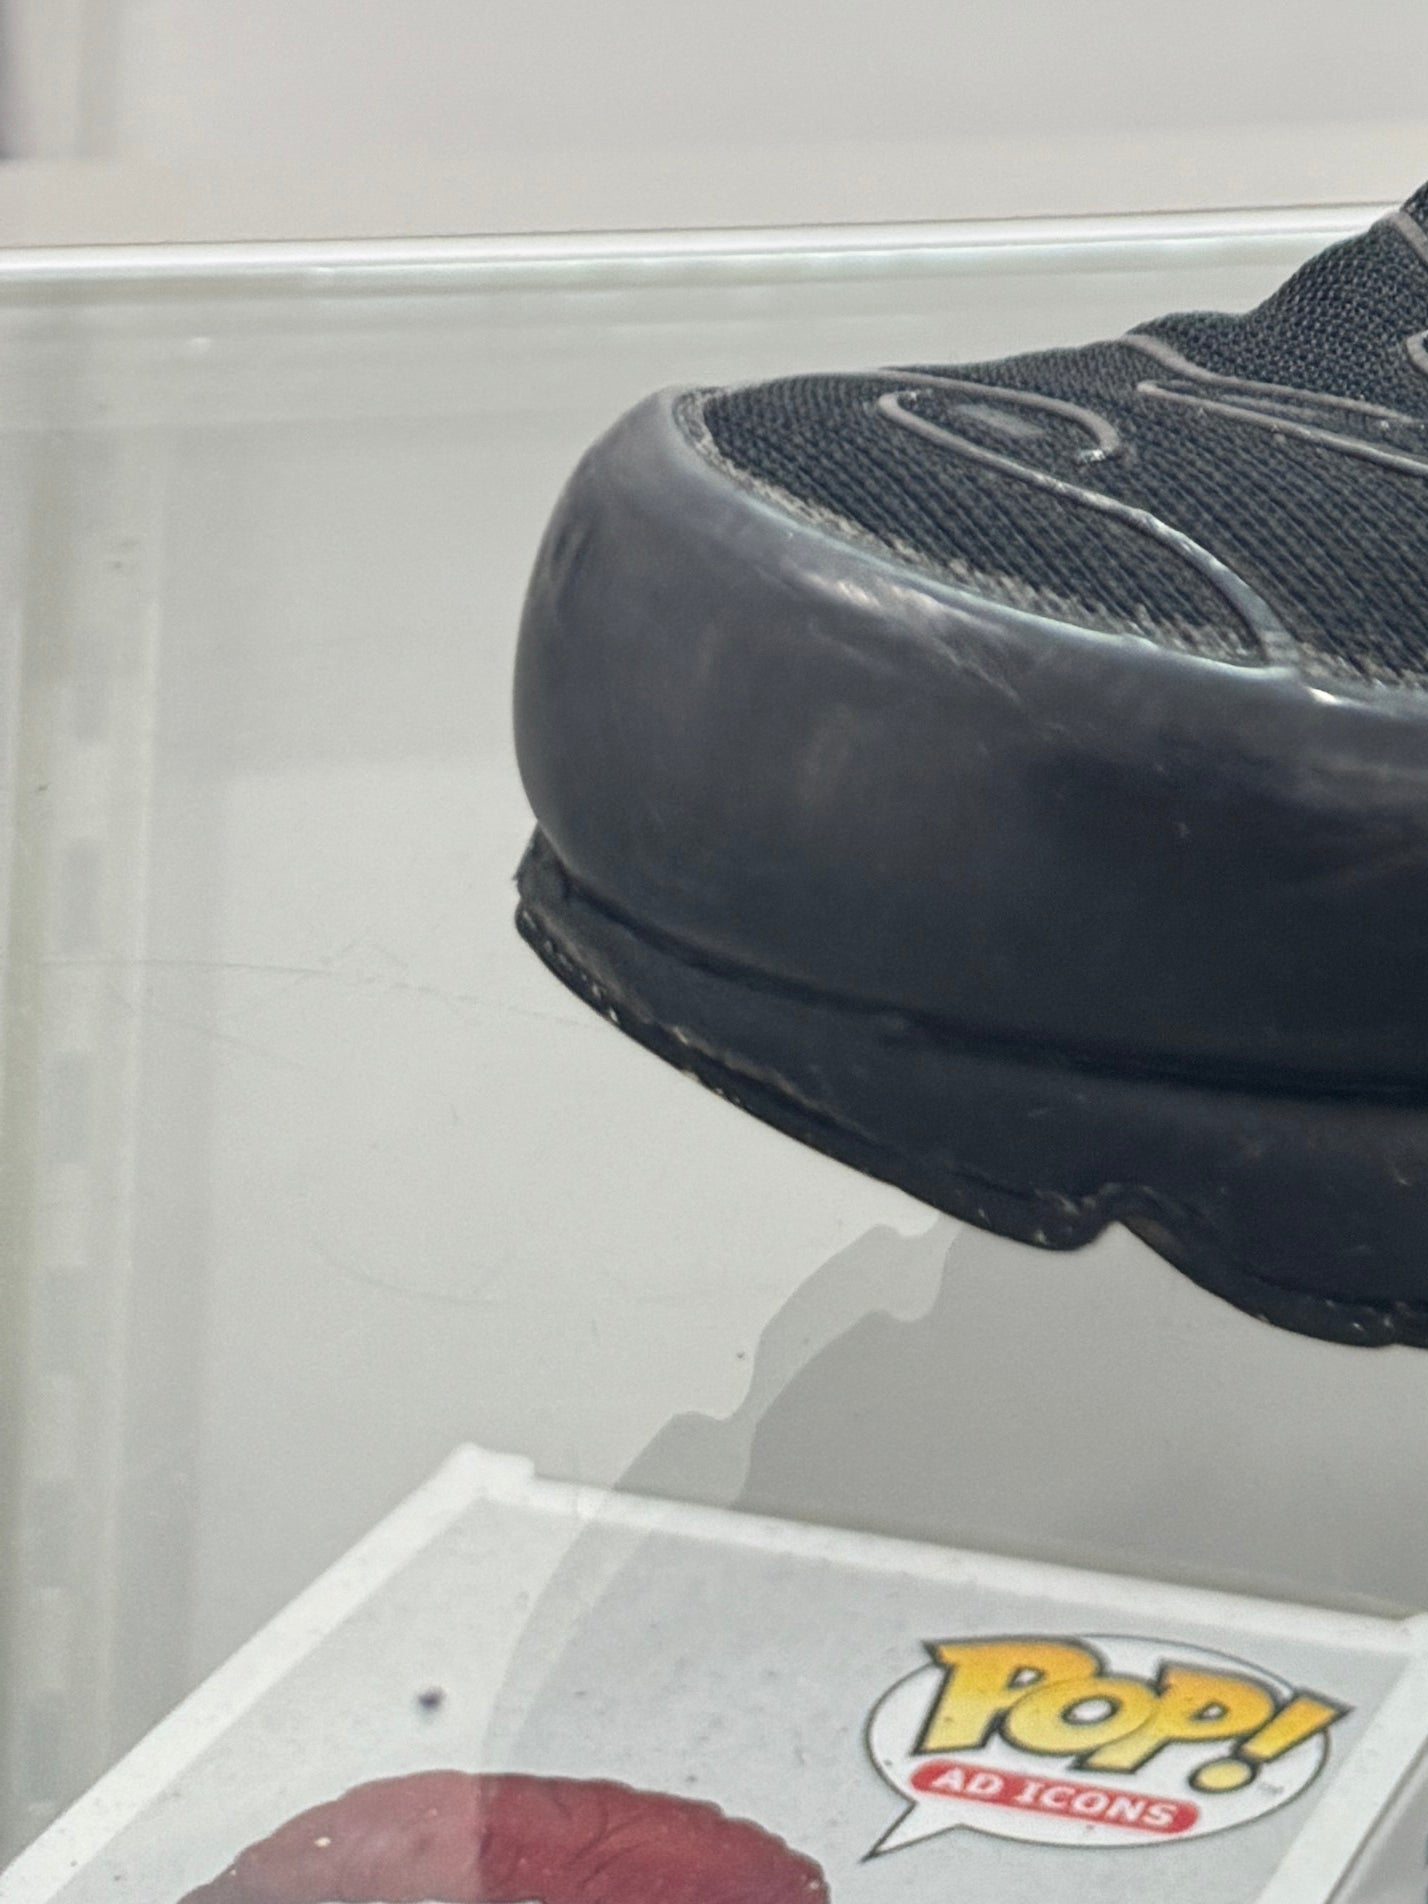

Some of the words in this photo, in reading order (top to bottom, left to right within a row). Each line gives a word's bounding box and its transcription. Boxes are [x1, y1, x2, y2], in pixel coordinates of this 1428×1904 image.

[909, 1636, 1355, 1793] POP!
[930, 1766, 1004, 1795] AD
[1015, 1775, 1179, 1827] ICONS
